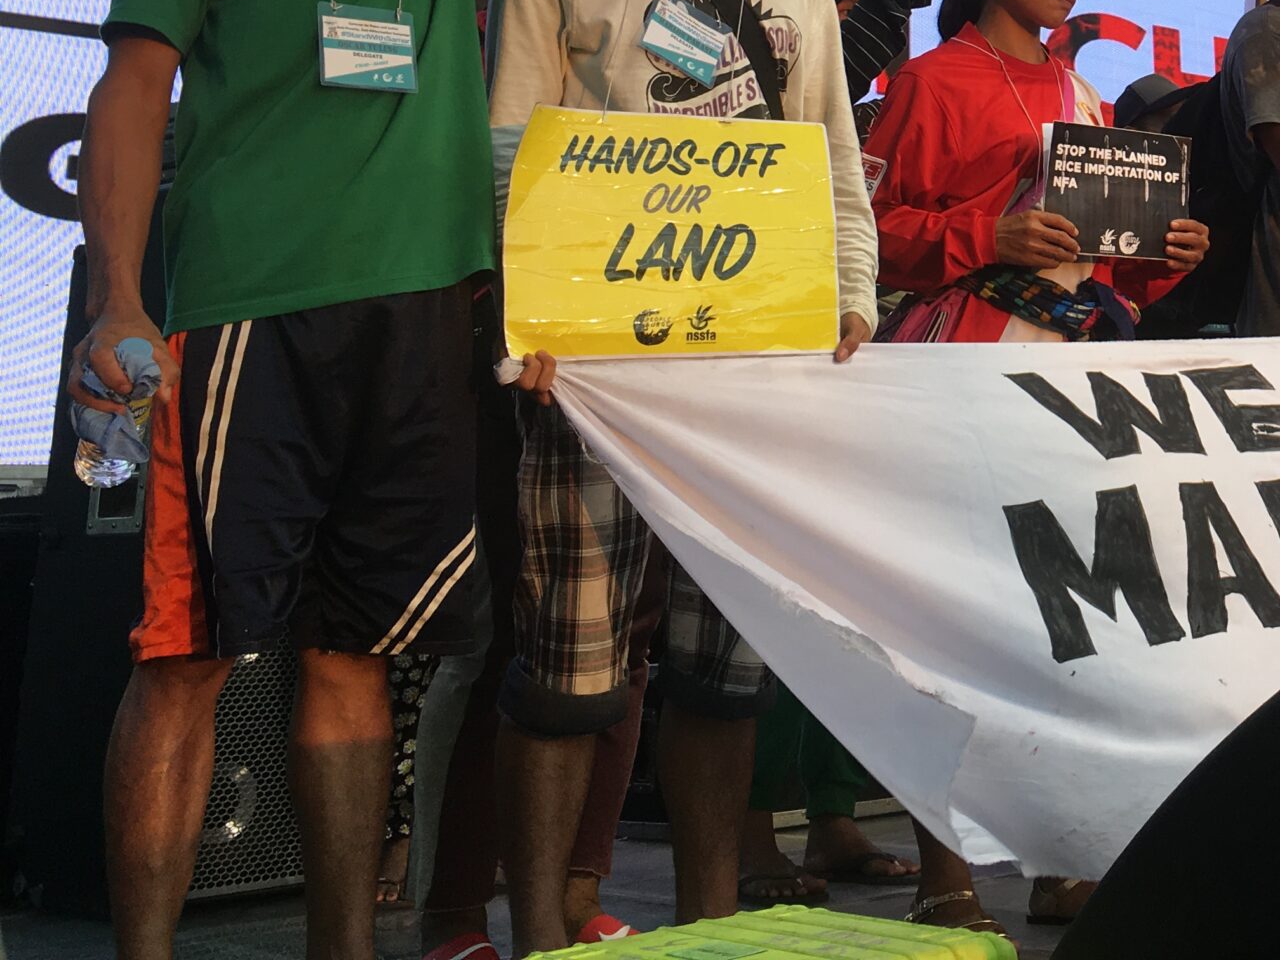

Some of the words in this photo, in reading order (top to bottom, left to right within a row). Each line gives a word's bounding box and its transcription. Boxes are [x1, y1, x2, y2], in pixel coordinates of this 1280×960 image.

[559, 134, 787, 178] HANDS-OFF
[1056, 143, 1087, 158] STOP
[1088, 146, 1113, 160] THE
[1114, 150, 1167, 167] PLANNED
[1052, 175, 1078, 189] NFA
[1054, 159, 1082, 174] RICE
[1084, 162, 1163, 182] IMPORTATION
[1163, 171, 1180, 184] OF
[642, 182, 712, 214] OUR
[603, 221, 757, 283] LAND
[685, 329, 717, 342] nssfa
